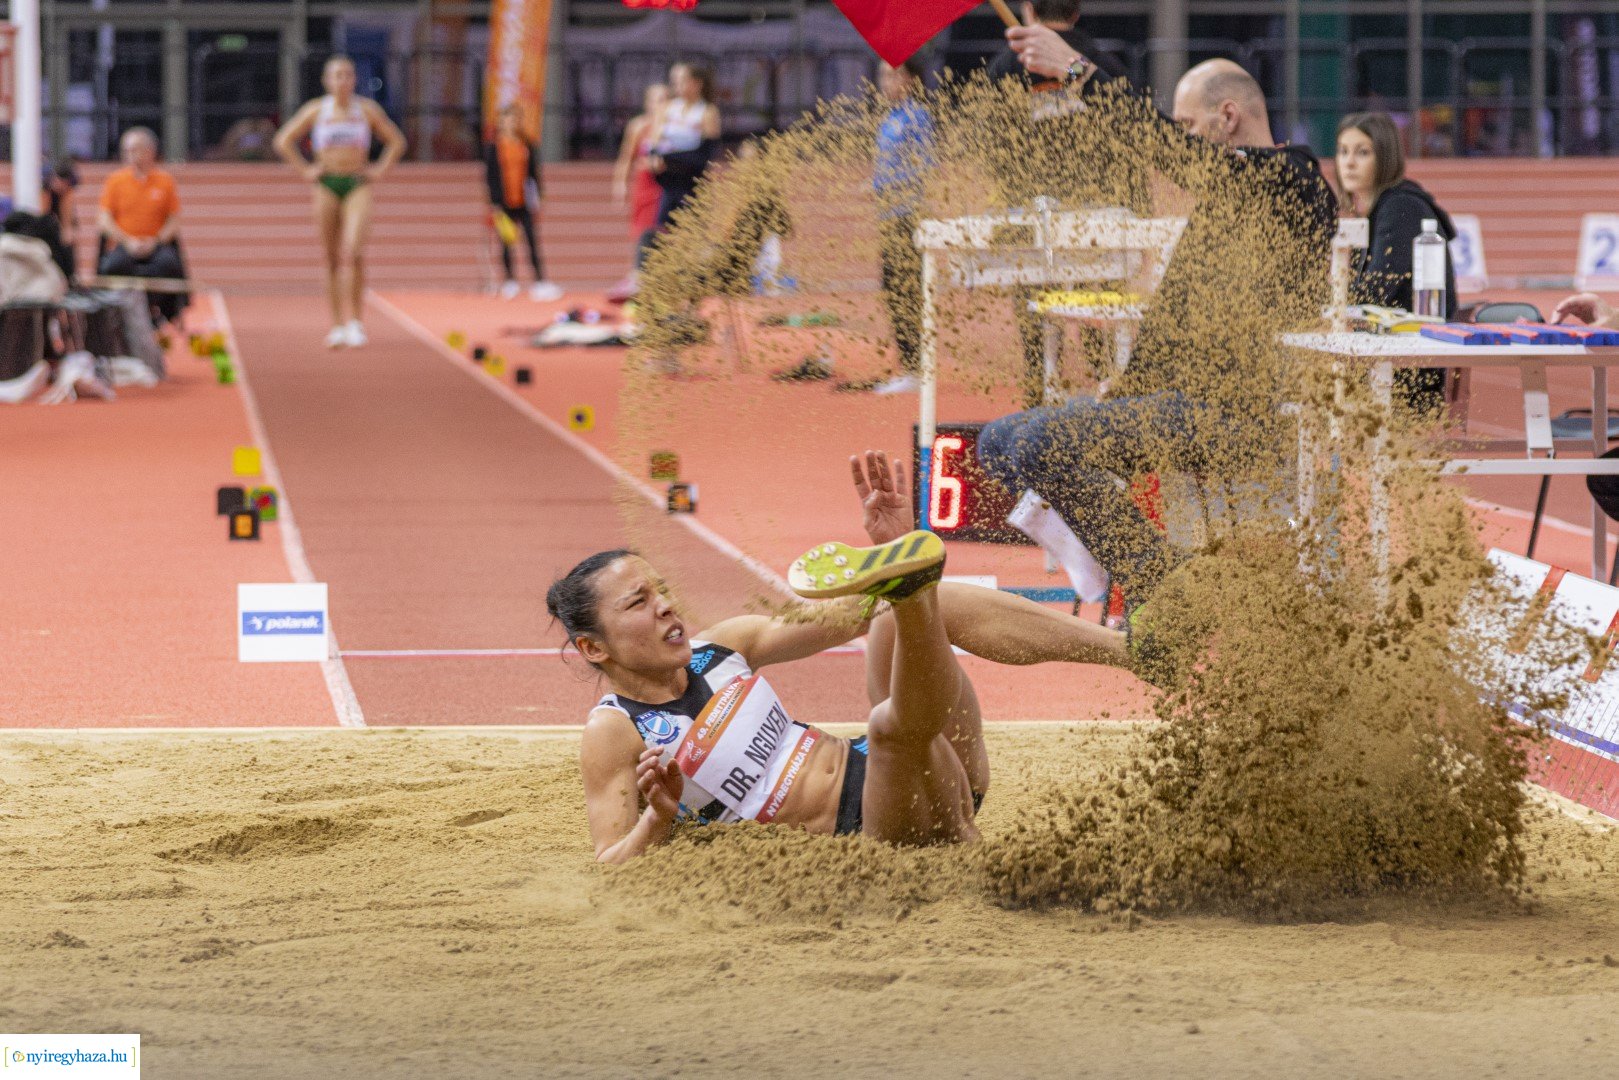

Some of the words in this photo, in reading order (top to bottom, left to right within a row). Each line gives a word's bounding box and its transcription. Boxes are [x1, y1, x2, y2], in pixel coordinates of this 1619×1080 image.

[1594, 227, 1618, 273] 2
[929, 436, 962, 529] 6
[720, 767, 761, 803] DR.
[744, 701, 788, 769] NGUYEN
